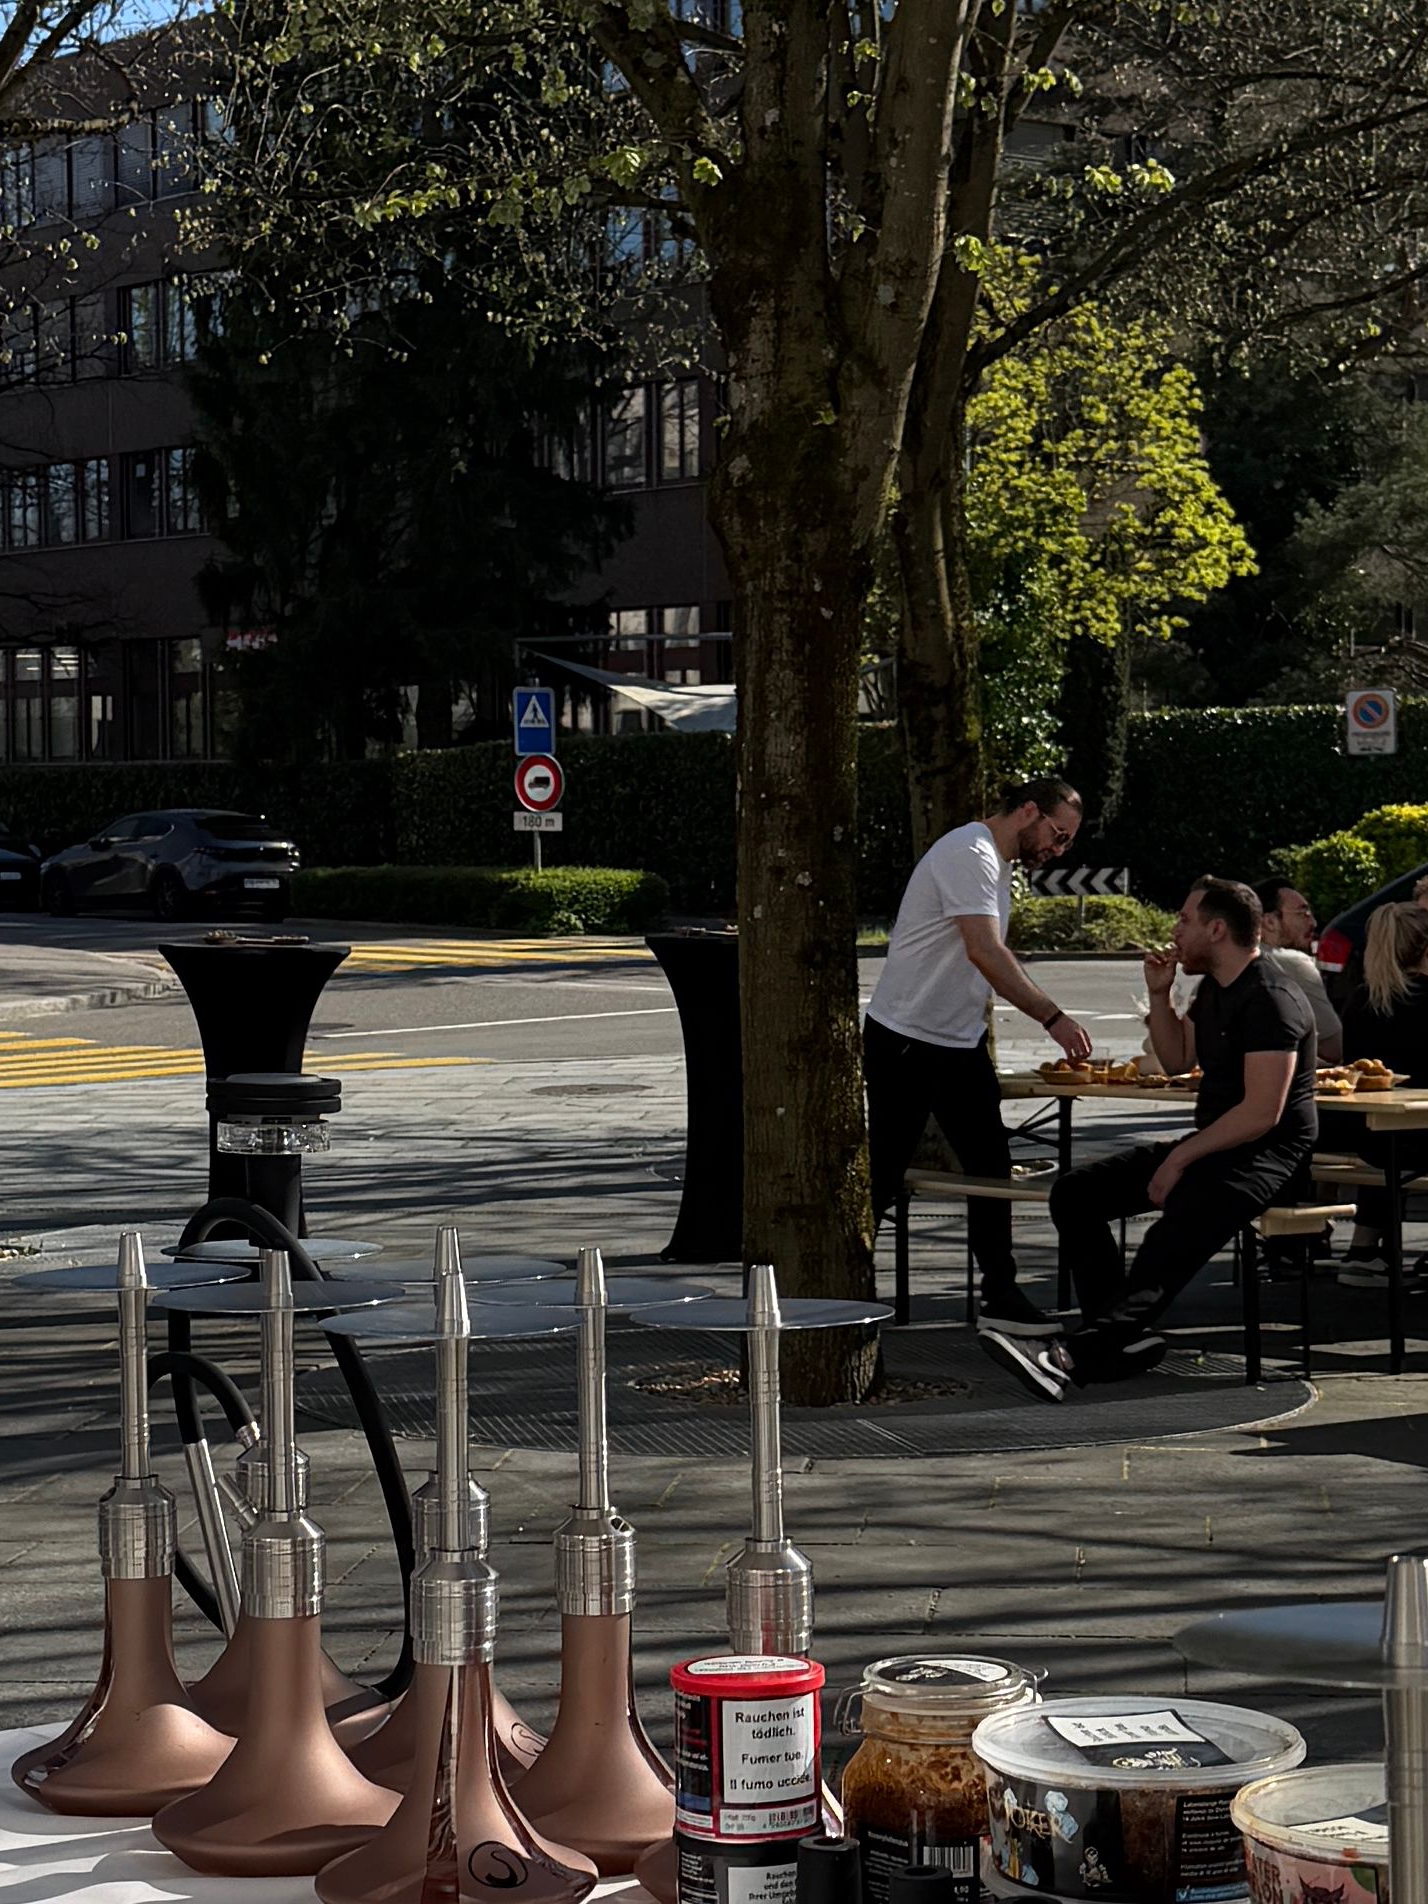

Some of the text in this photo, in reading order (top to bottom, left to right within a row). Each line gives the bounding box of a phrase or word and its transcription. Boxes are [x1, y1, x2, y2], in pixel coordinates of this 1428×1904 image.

[735, 1707, 805, 1724] Rauchen ist
[742, 1753, 782, 1765] Fumer
[730, 1780, 737, 1790] Il
[741, 1778, 773, 1790] fumo
[1004, 1800, 1072, 1844] JOKER
